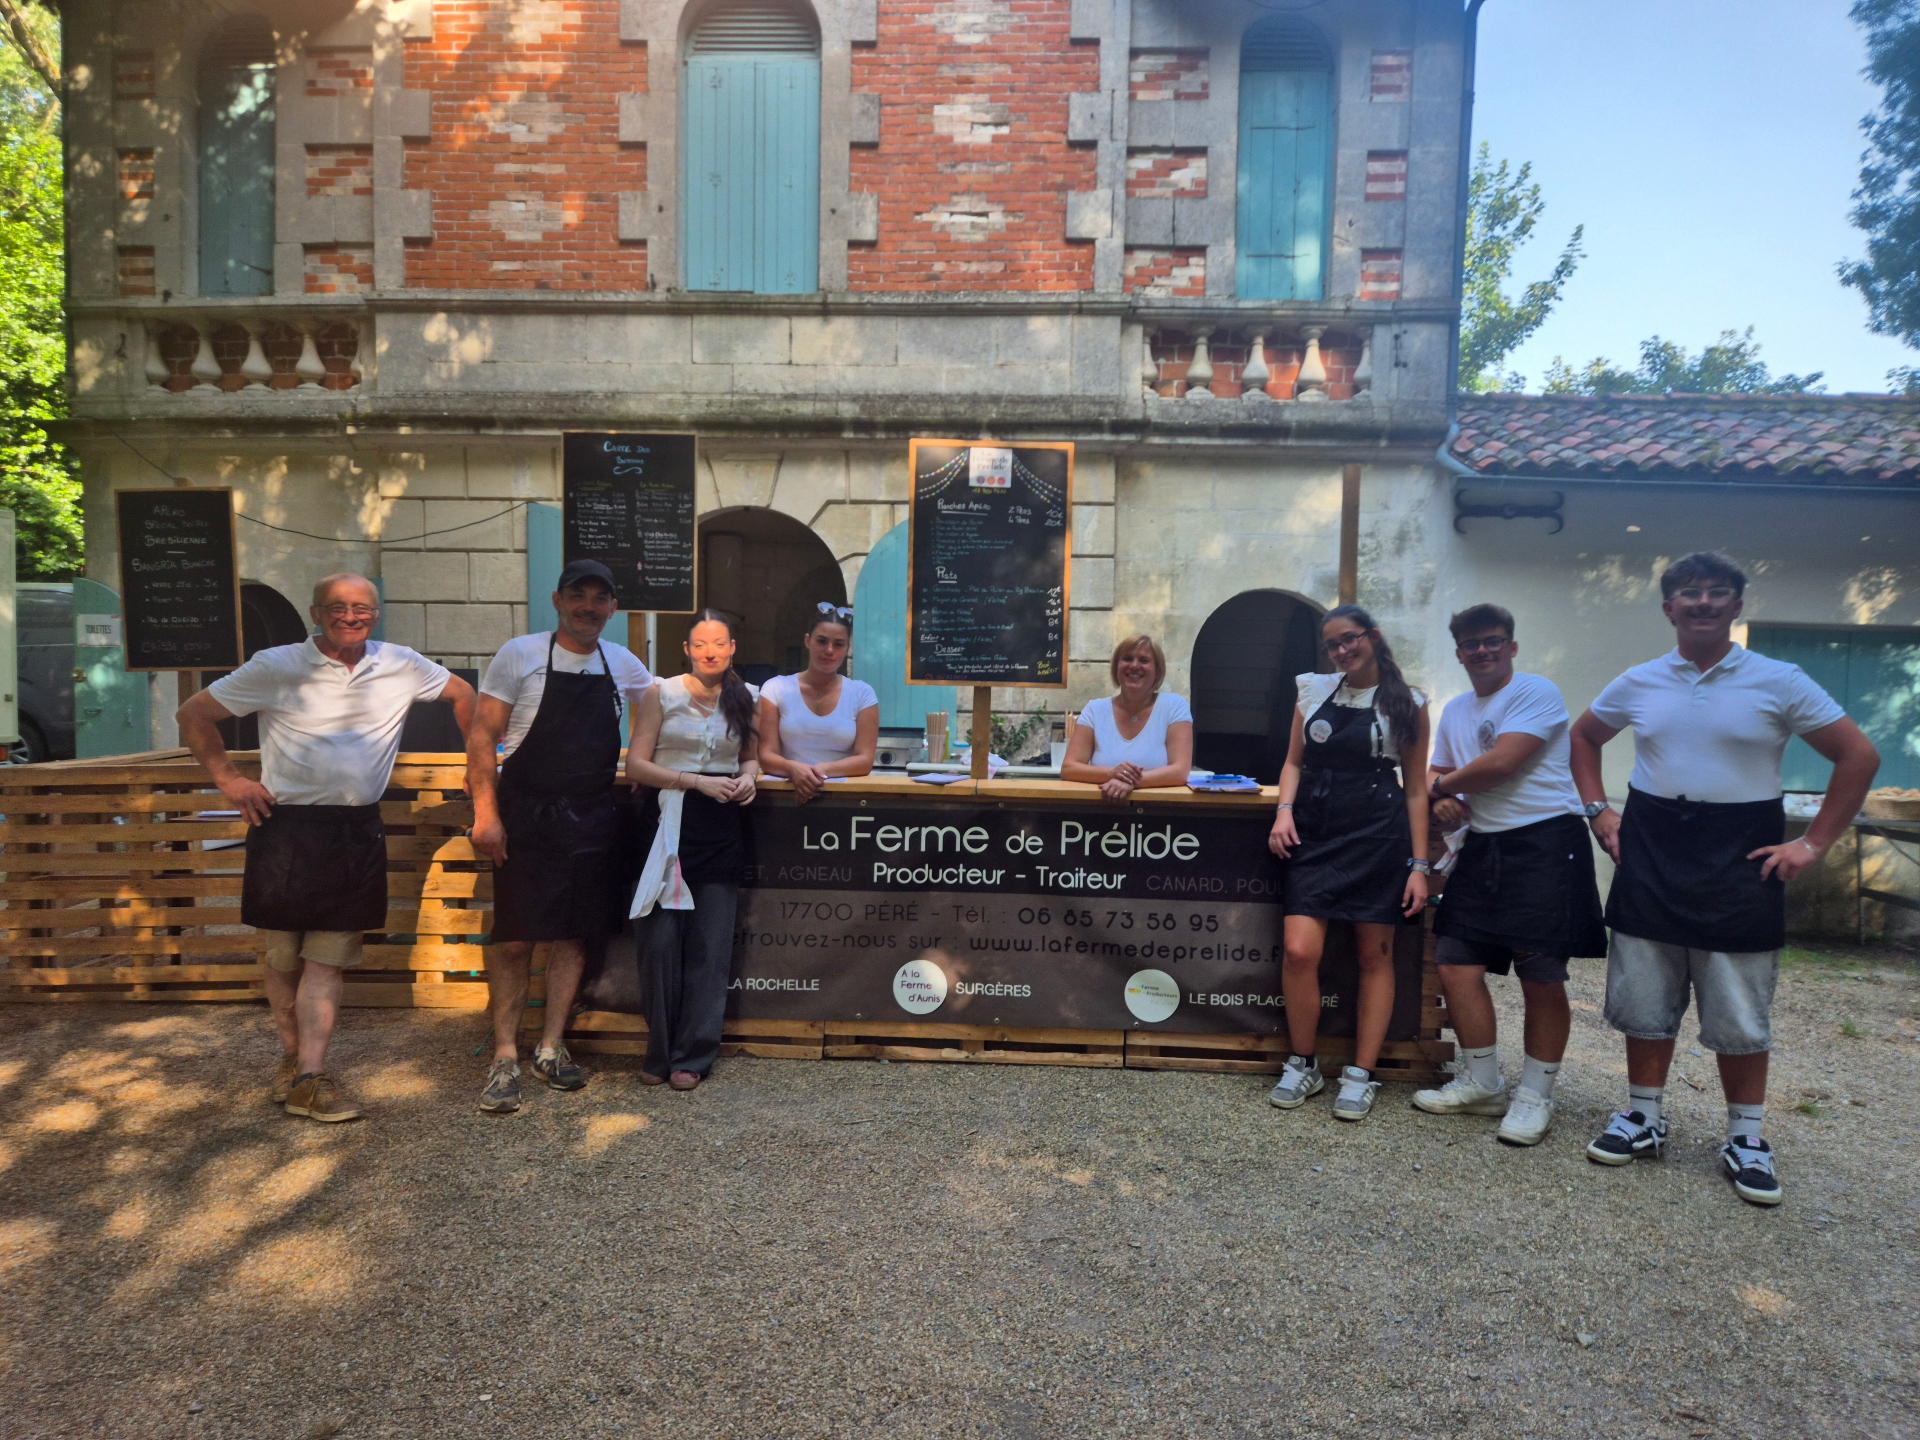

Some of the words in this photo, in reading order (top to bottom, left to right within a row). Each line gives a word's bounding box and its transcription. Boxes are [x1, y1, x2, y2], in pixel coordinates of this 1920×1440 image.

[937, 498, 966, 510] Planches
[1008, 506, 1014, 514] 2
[1008, 515, 1014, 523] 4
[935, 565, 958, 579] Plats
[803, 825, 839, 851] La
[850, 816, 990, 854] Ferme
[1005, 829, 1044, 856] de
[1060, 820, 1200, 861] Prélide
[777, 865, 852, 882] AGNEAU
[873, 861, 1006, 885] Producteur
[1035, 865, 1127, 890] Traiteur
[1237, 878, 1285, 895] POUL
[780, 902, 853, 921] 17700
[865, 900, 919, 921] PÉRÉ
[952, 905, 990, 923] Tél.
[1017, 907, 1051, 925] 06
[1063, 909, 1093, 928] 85
[1105, 911, 1134, 930] 73
[1146, 912, 1177, 931] 58
[1189, 913, 1220, 933] 95
[732, 928, 897, 949] etrouvez-nous
[909, 935, 942, 949] sur
[969, 934, 1282, 964] www.lafermedeprelide.f
[901, 969, 908, 978] A
[911, 969, 920, 978] la
[746, 978, 820, 991] ROCHELLE
[900, 980, 932, 990] Ferme
[955, 981, 1032, 997] SURGÈRES
[908, 994, 941, 1003] d'Aunis
[1146, 991, 1178, 999] Producteurs
[1189, 993, 1207, 1005] LE
[1210, 993, 1244, 1006] BOIS
[1247, 994, 1285, 1007] PLAG
[1321, 994, 1340, 1008] RÉ
